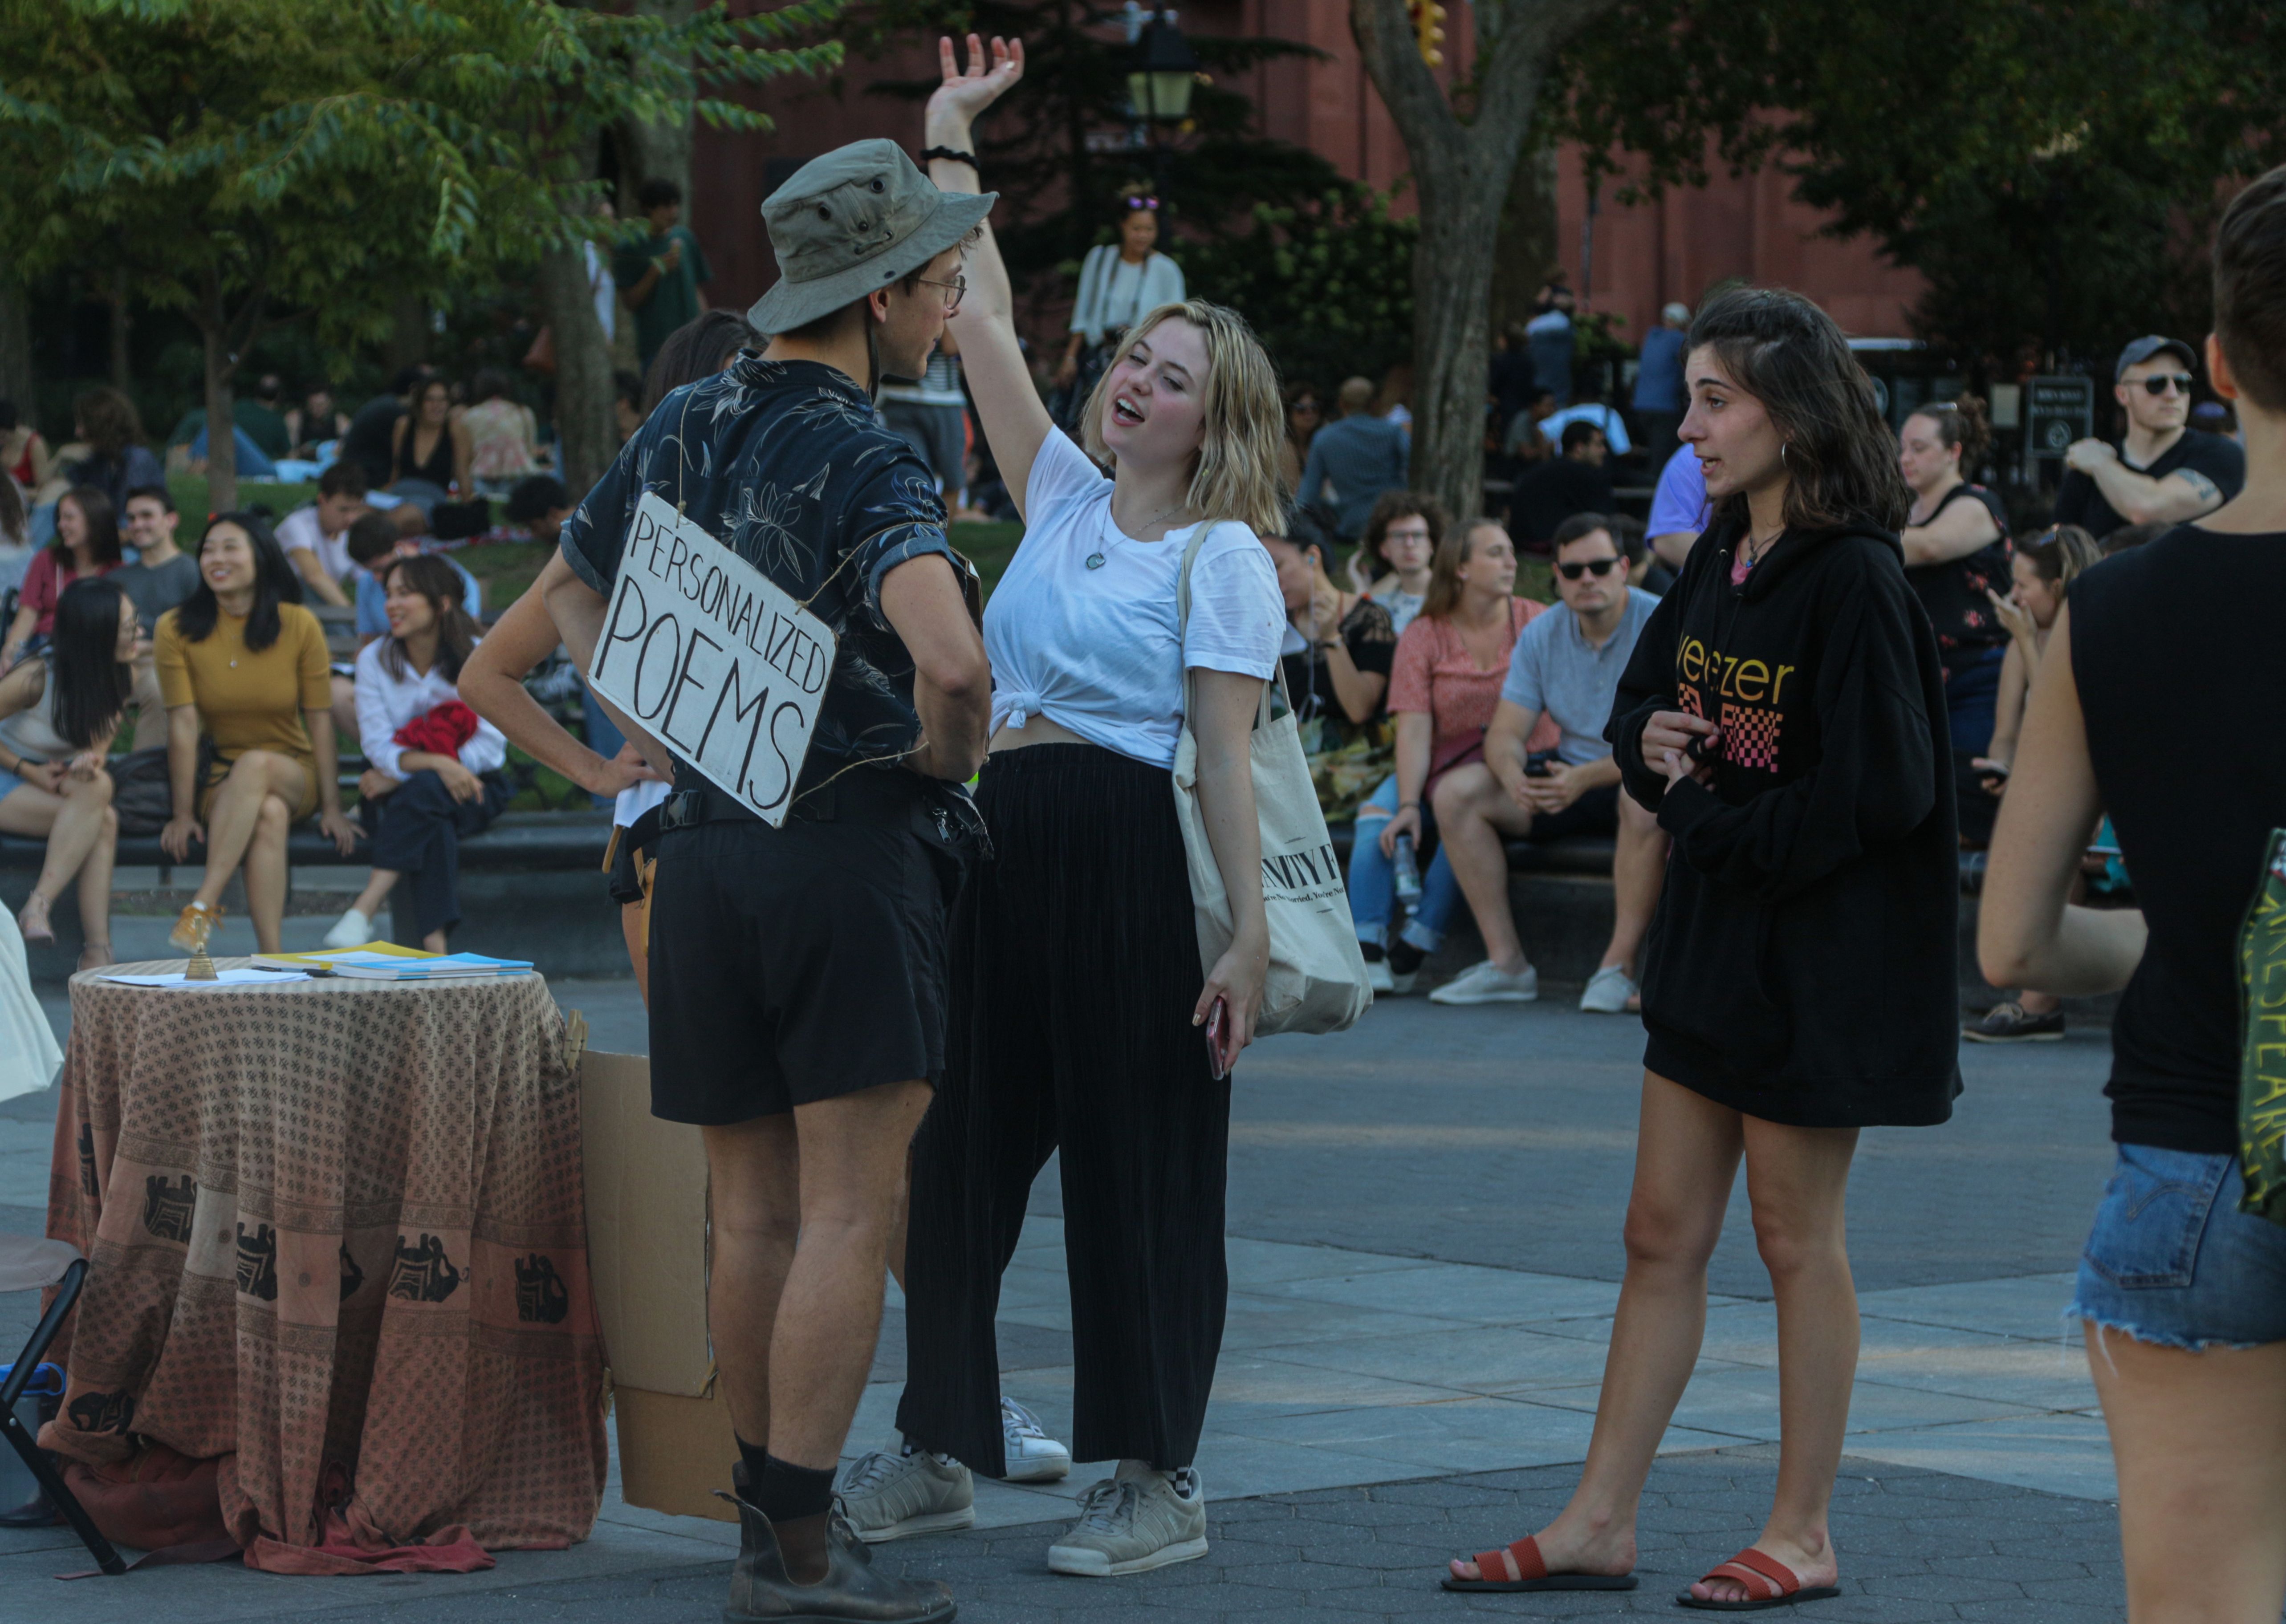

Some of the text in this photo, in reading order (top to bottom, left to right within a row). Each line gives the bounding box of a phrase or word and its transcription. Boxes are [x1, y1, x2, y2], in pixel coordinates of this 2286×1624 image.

[596, 575, 804, 810] POEMS
[630, 511, 826, 694] PERSONALIZED
[1261, 849, 1322, 889] ANITY
